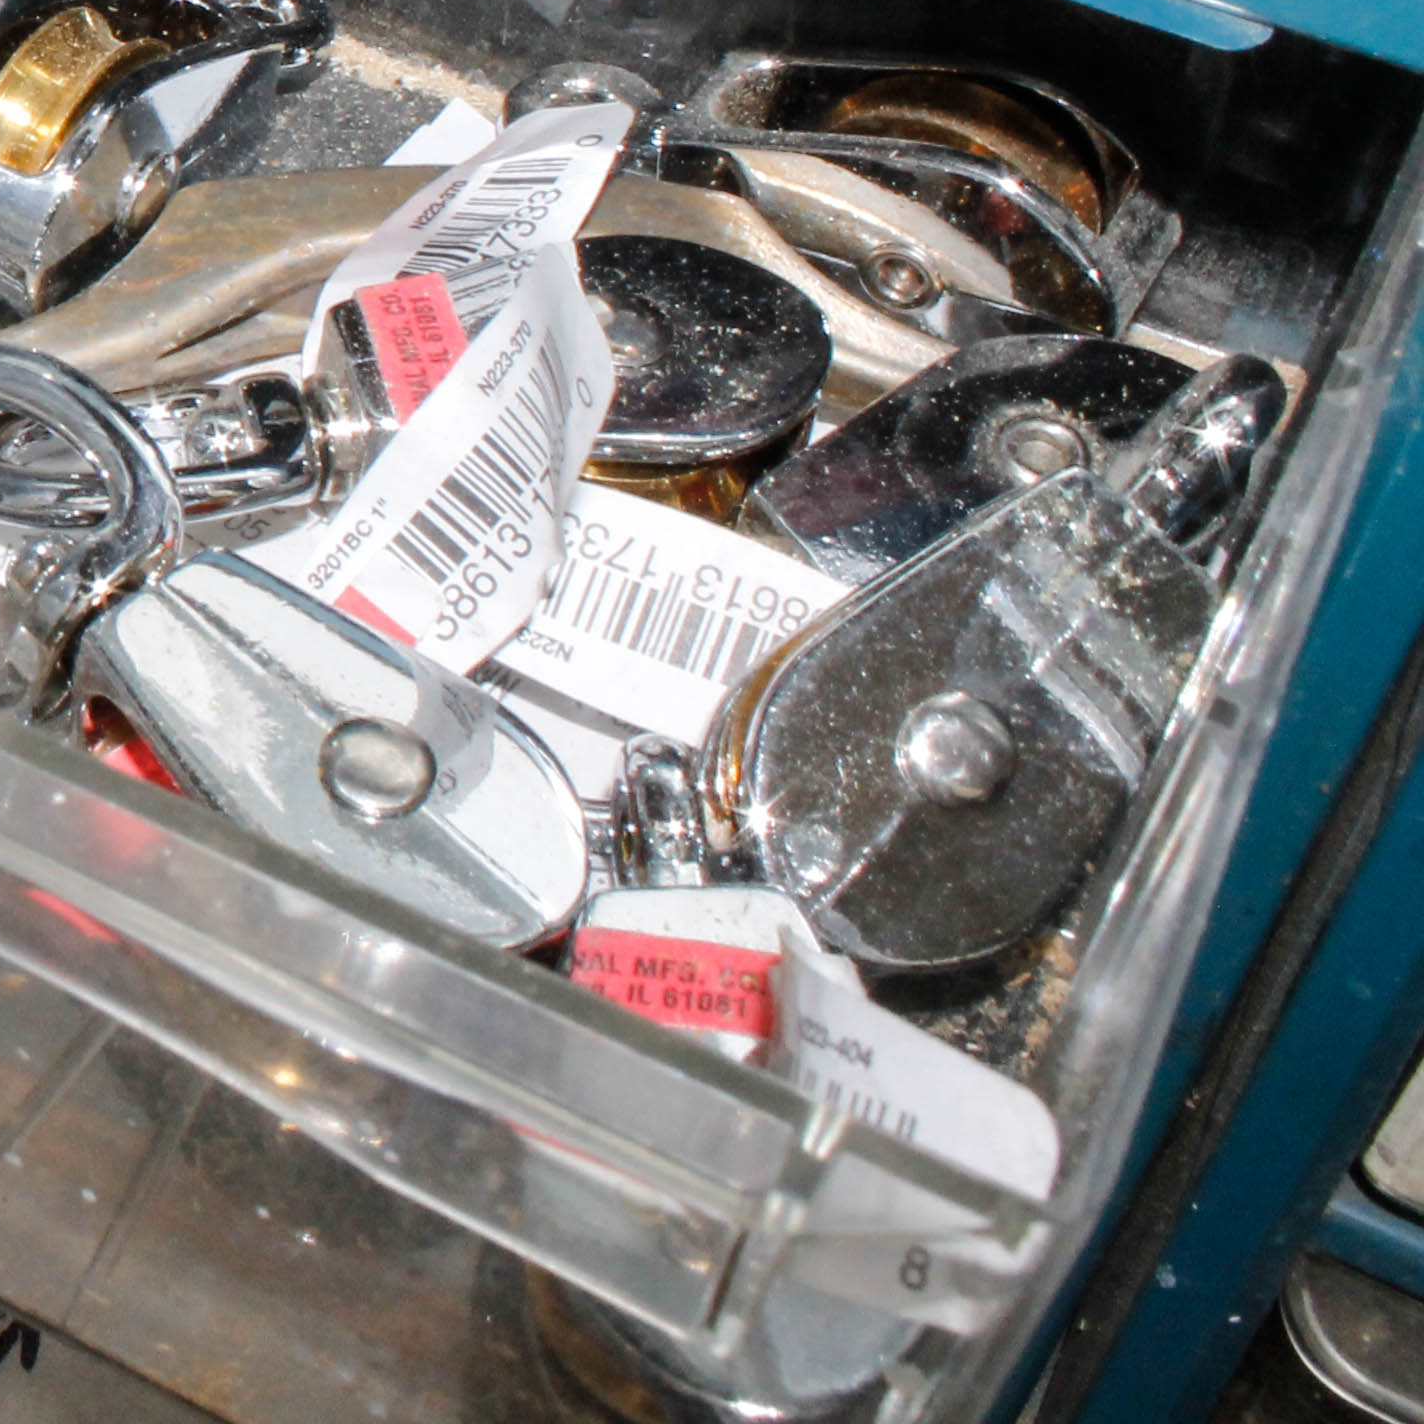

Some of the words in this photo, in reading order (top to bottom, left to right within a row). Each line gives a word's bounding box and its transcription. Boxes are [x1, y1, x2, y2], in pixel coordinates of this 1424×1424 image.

[476, 319, 532, 398] N223-370
[690, 564, 824, 634] 8613
[627, 984, 652, 1006] IL
[662, 988, 748, 1018] 61081
